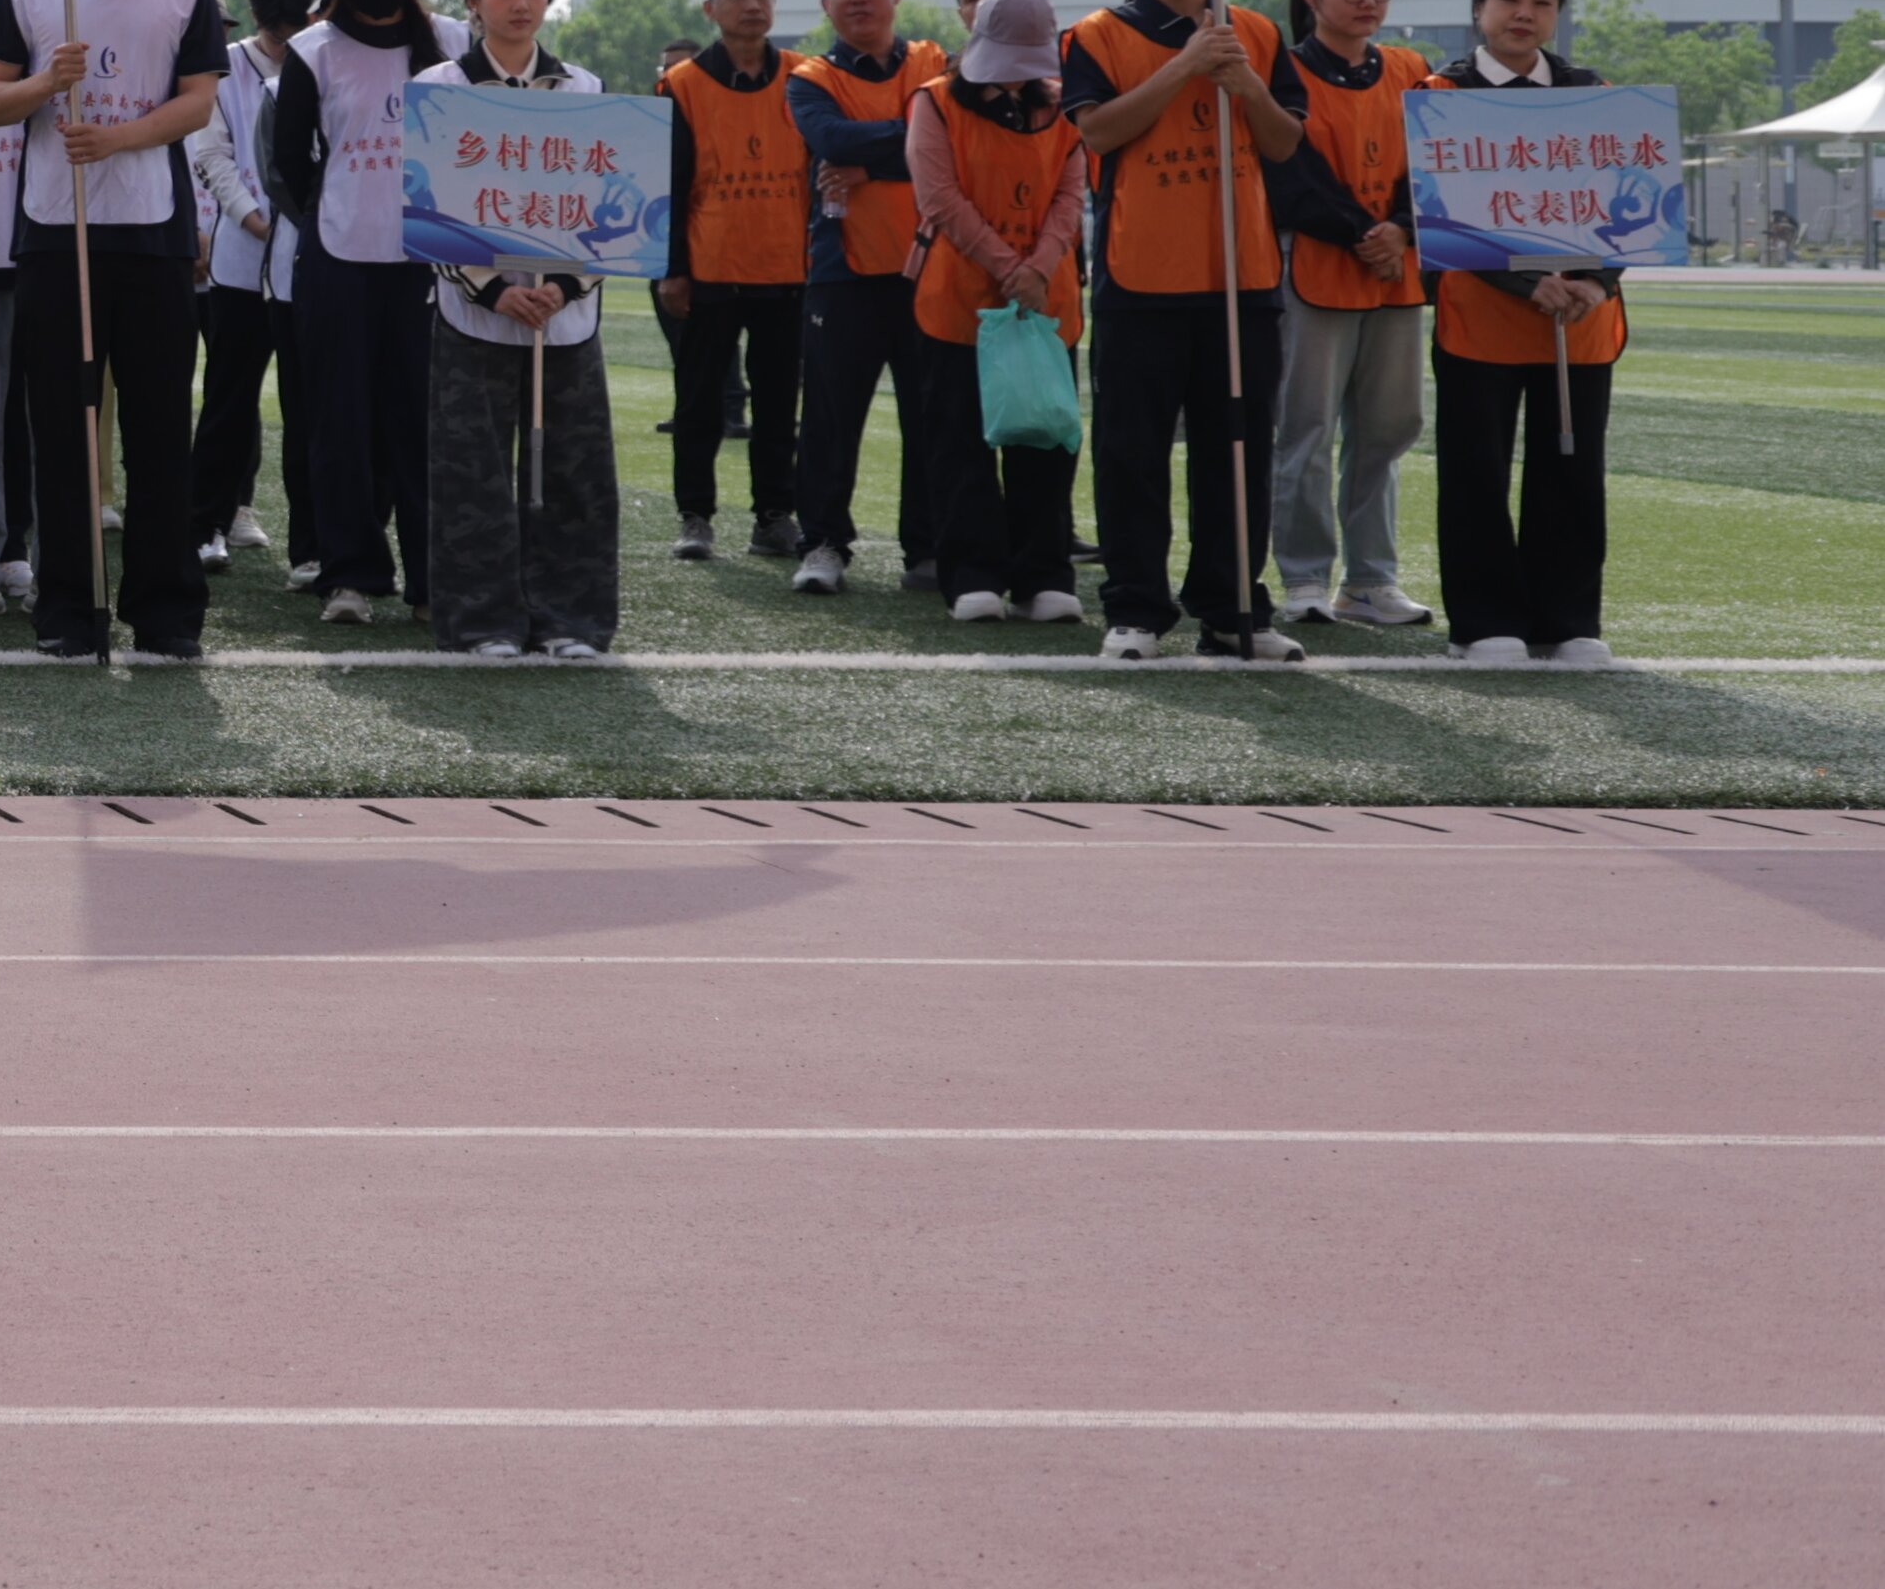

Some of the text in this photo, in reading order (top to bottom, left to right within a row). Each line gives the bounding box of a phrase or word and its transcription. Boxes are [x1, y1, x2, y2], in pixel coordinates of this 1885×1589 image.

[453, 130, 621, 175] 乡村供水
[1423, 133, 1670, 173] 王山水库供水
[474, 187, 597, 230] 代表队
[1488, 189, 1611, 226] 代表队
